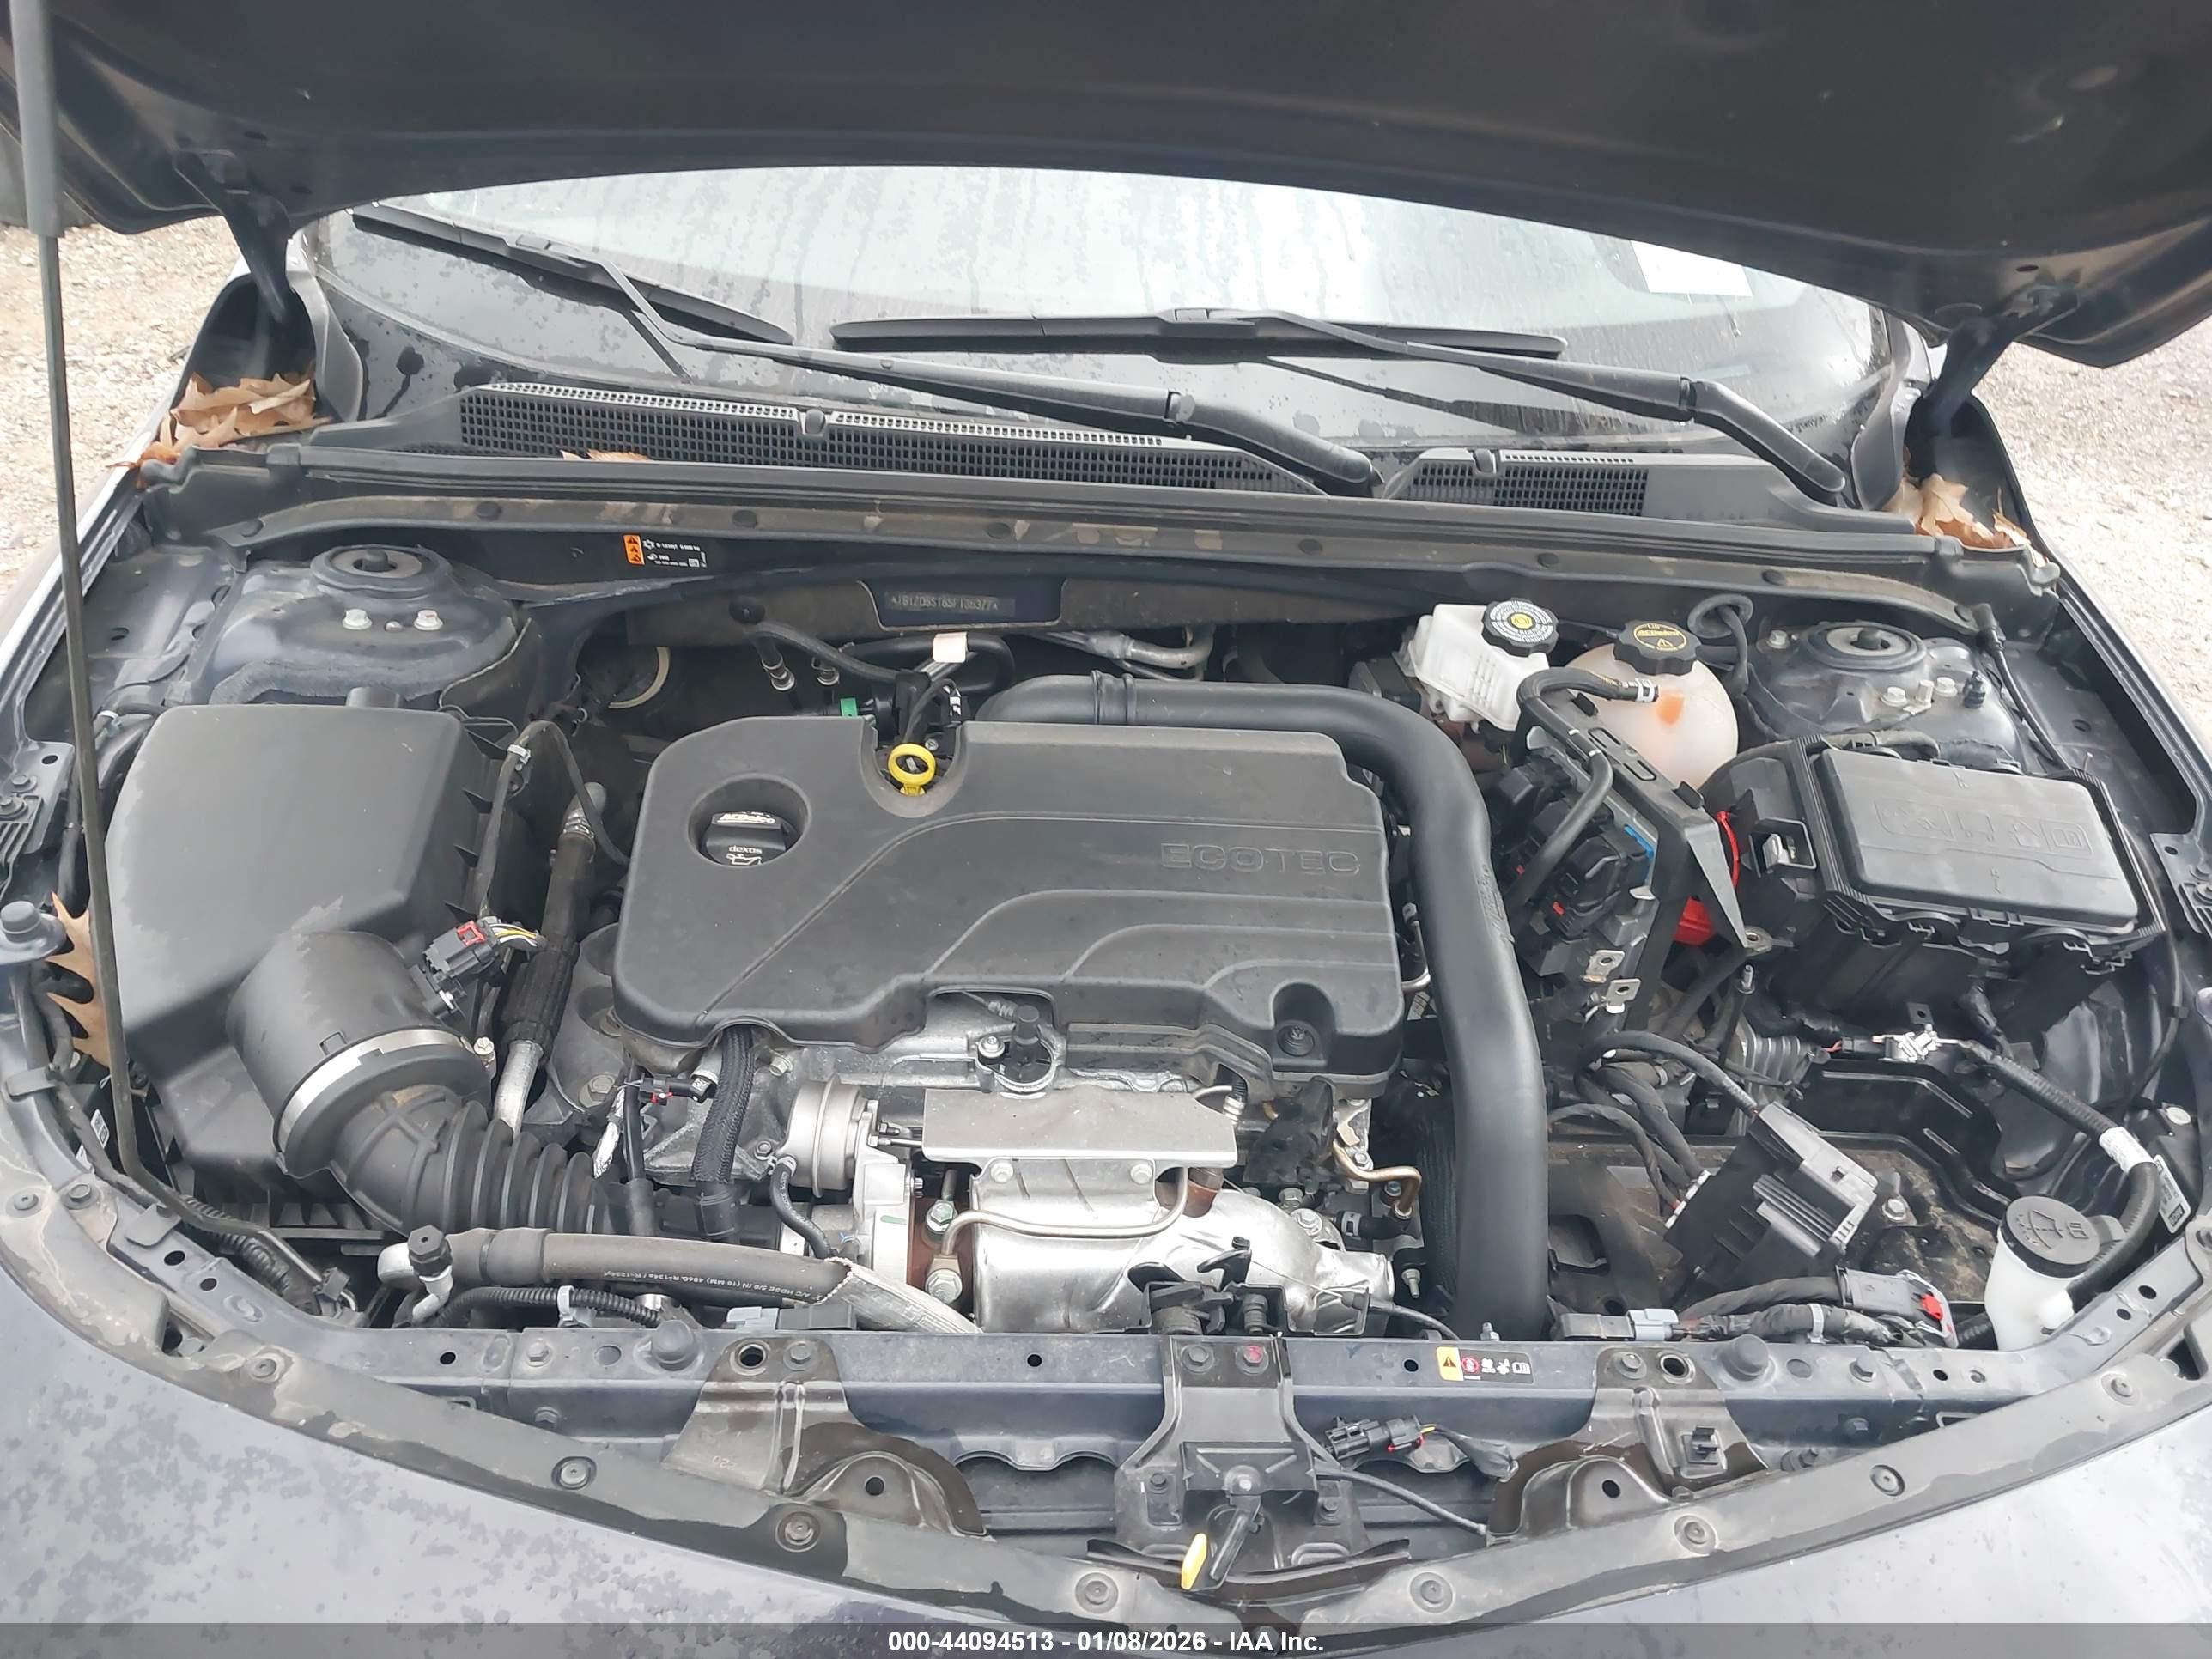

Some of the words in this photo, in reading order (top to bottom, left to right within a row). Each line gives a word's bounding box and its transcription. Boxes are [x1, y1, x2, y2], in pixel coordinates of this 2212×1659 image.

[728, 845, 763, 854] dexos
[1160, 843, 1360, 874] ECOTEC
[769, 1286, 794, 1296] HOSE
